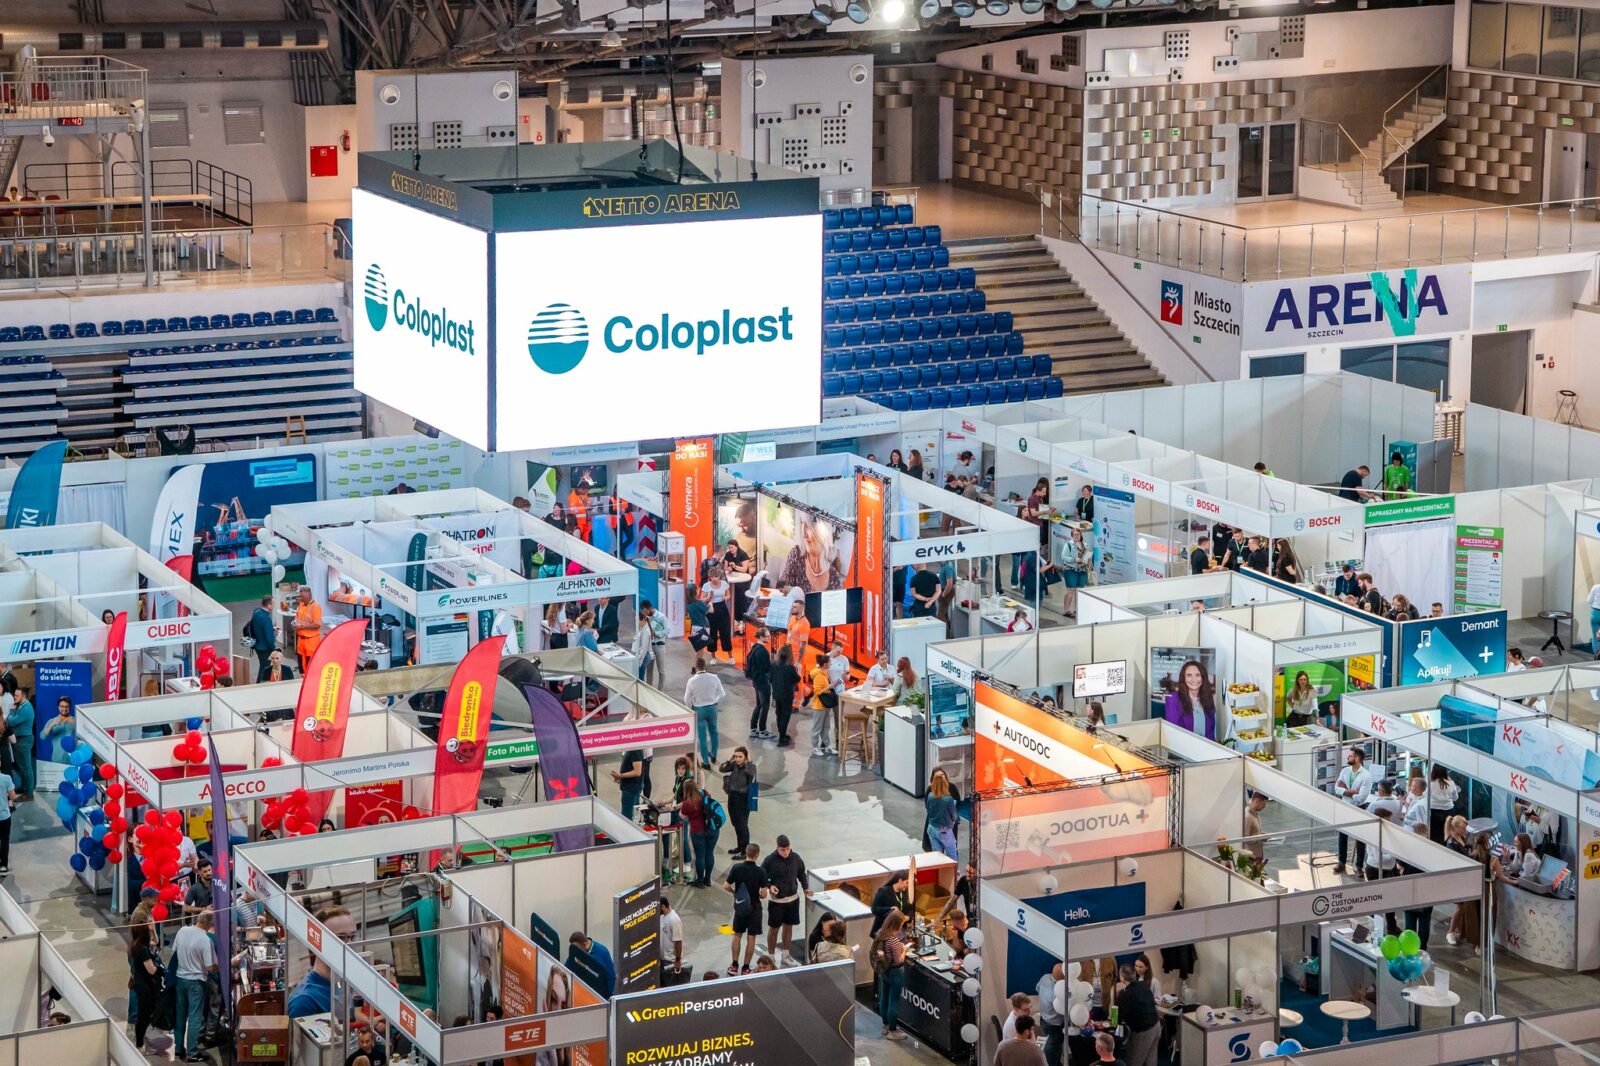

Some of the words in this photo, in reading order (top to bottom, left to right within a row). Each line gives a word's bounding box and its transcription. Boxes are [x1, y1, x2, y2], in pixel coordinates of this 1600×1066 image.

[391, 171, 423, 200] NETTO
[425, 183, 458, 211] ARENA
[583, 196, 660, 218] NETTO
[665, 191, 740, 213] ARENA
[1194, 290, 1231, 314] Miasto
[393, 289, 474, 356] Coloplast
[1193, 310, 1240, 337] Szczecin
[604, 307, 793, 355] Coloplast
[1307, 329, 1344, 338] SZCZECIN
[1132, 478, 1154, 493] BOSCH
[684, 477, 693, 519] Nemera
[1196, 499, 1220, 514] BOSCH
[1368, 508, 1404, 518] ZAPRASZAMY
[1413, 503, 1450, 512] PREZENTACJE
[20, 508, 39, 528] KI
[1309, 516, 1341, 528] BOSCH
[1460, 537, 1500, 546] PREZENTACJE
[1145, 568, 1164, 579] BOSCH
[556, 577, 610, 591] ALPHATRON
[450, 593, 508, 605] POWERLINES
[557, 589, 579, 597] Alphatron
[580, 587, 595, 595] Marine
[147, 622, 191, 638] CUBIC
[1461, 618, 1499, 632] Demant
[19, 635, 77, 654] ACTION
[40, 667, 72, 675] Pasujemy
[941, 660, 961, 678] salling
[1417, 664, 1451, 678] Aplikuj!
[319, 666, 334, 717] Biedronka
[461, 686, 475, 737] Biedronka
[1371, 713, 1386, 734] KK
[594, 735, 621, 744] wykonasz
[1503, 723, 1523, 747] KK
[487, 747, 507, 756] Foto
[509, 744, 535, 754] Punkt
[1004, 727, 1051, 759] AUTODOC
[332, 767, 362, 777] Jeronimo
[363, 763, 387, 772] Martins
[388, 760, 410, 769] Polska
[199, 780, 266, 800] Aecco
[1511, 772, 1527, 793] KK
[1332, 894, 1383, 907] CUSTOMIZATION
[1064, 907, 1091, 921] Hello,
[1331, 906, 1354, 914] GROUP
[619, 912, 632, 926] NASZE
[623, 920, 637, 931] TWOJE
[313, 931, 321, 943] TE
[505, 970, 520, 985] WHEN
[511, 999, 526, 1014] DOES
[642, 992, 744, 1020] GremiPersonal
[901, 987, 941, 1019] UTODOC
[408, 1013, 415, 1028] TE
[525, 1027, 541, 1040] TE
[626, 1041, 698, 1064] ROZWIJAJ
[702, 1033, 754, 1052] BIZNES,
